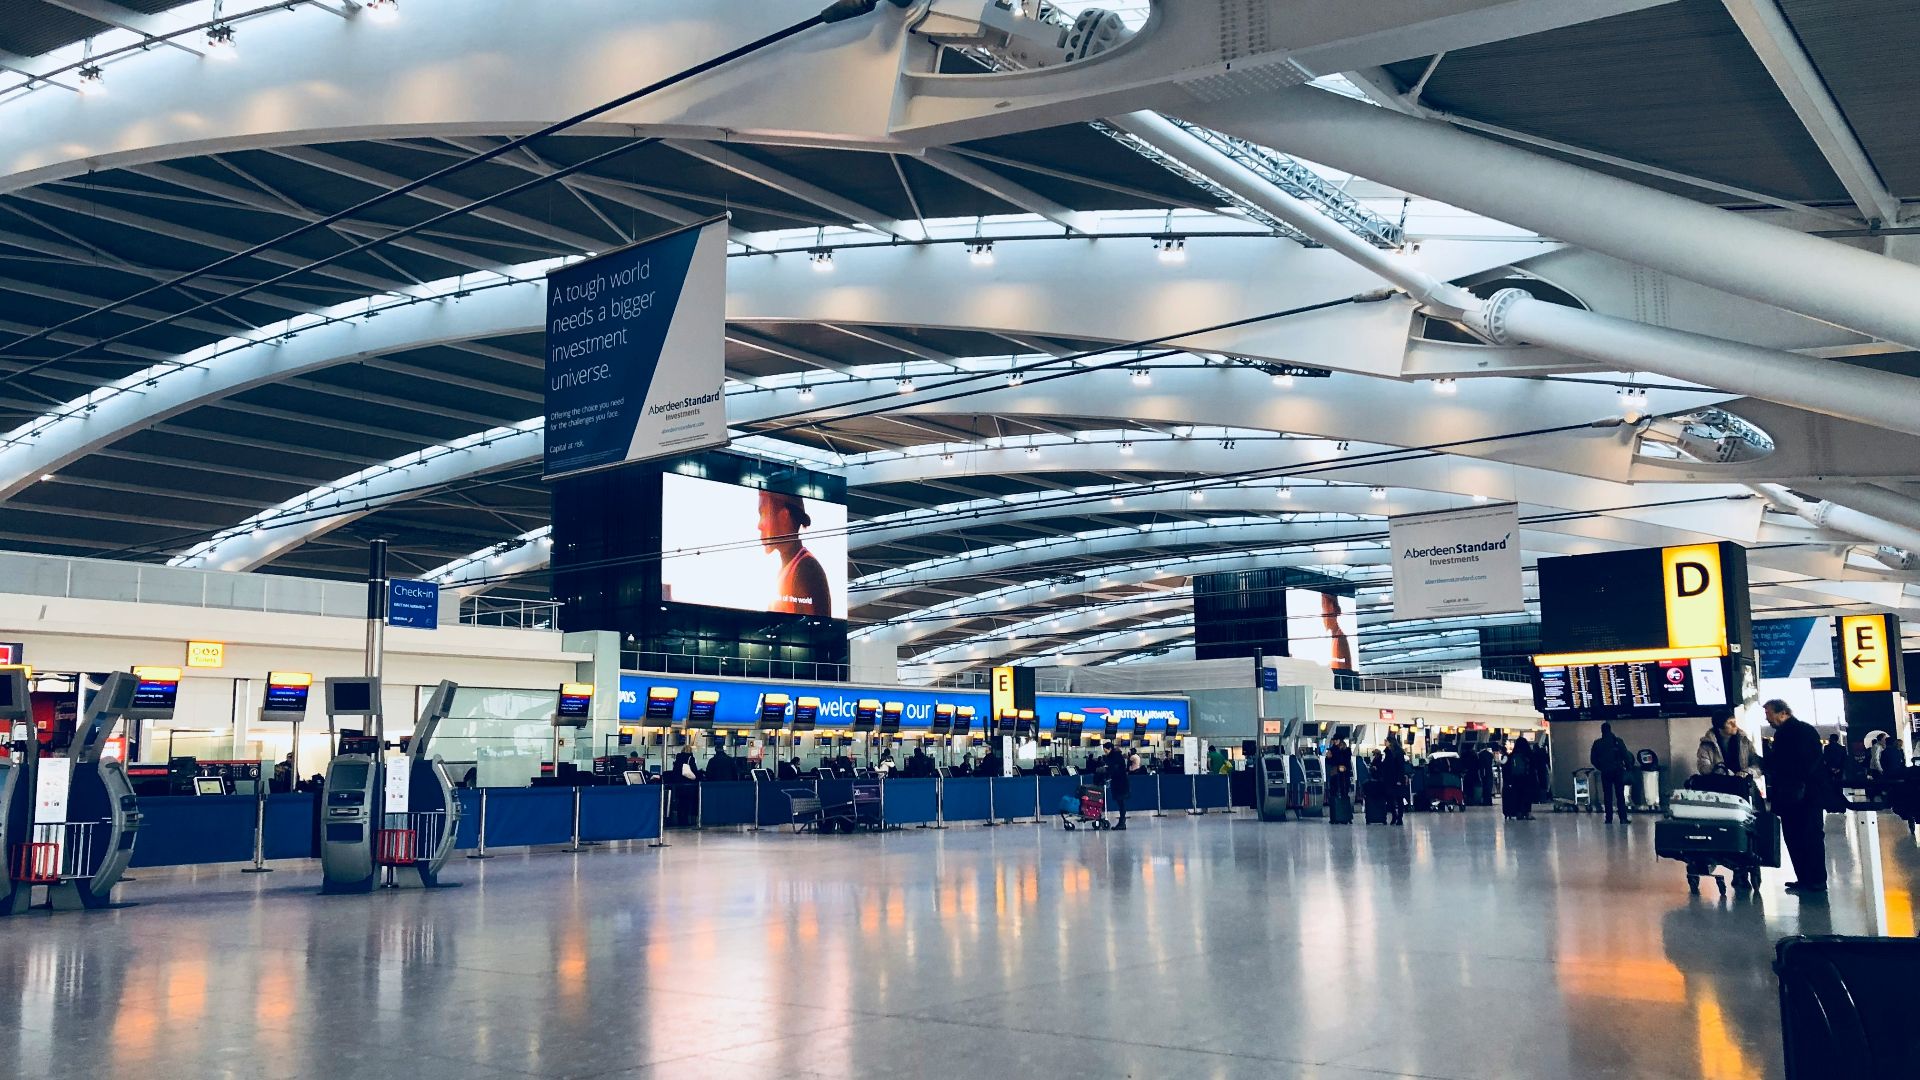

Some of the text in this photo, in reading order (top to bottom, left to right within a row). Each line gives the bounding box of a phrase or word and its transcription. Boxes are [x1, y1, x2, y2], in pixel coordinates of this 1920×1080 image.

[552, 257, 651, 306] A tough world
[552, 290, 656, 335] needs a bigger
[552, 328, 628, 363] investment
[551, 363, 611, 391] universe.
[550, 409, 571, 421] Offering
[582, 404, 599, 413] choice
[599, 402, 610, 411] you
[611, 396, 625, 406] need
[647, 391, 720, 416] AberdeenStandard
[550, 423, 558, 431] for
[558, 421, 567, 429] the
[568, 415, 595, 426] challenges
[595, 413, 606, 423] you
[665, 408, 701, 421] Investments
[549, 443, 567, 454] Capital
[567, 442, 573, 450] at
[1403, 538, 1507, 559] AberdeenStandard
[1429, 554, 1480, 566] Investments
[1424, 574, 1488, 585] aberdeenstandard.com
[1676, 561, 1710, 598] D
[394, 584, 434, 599] Check-in
[1856, 626, 1875, 651] E
[998, 674, 1008, 692] E
[906, 703, 932, 720] our
